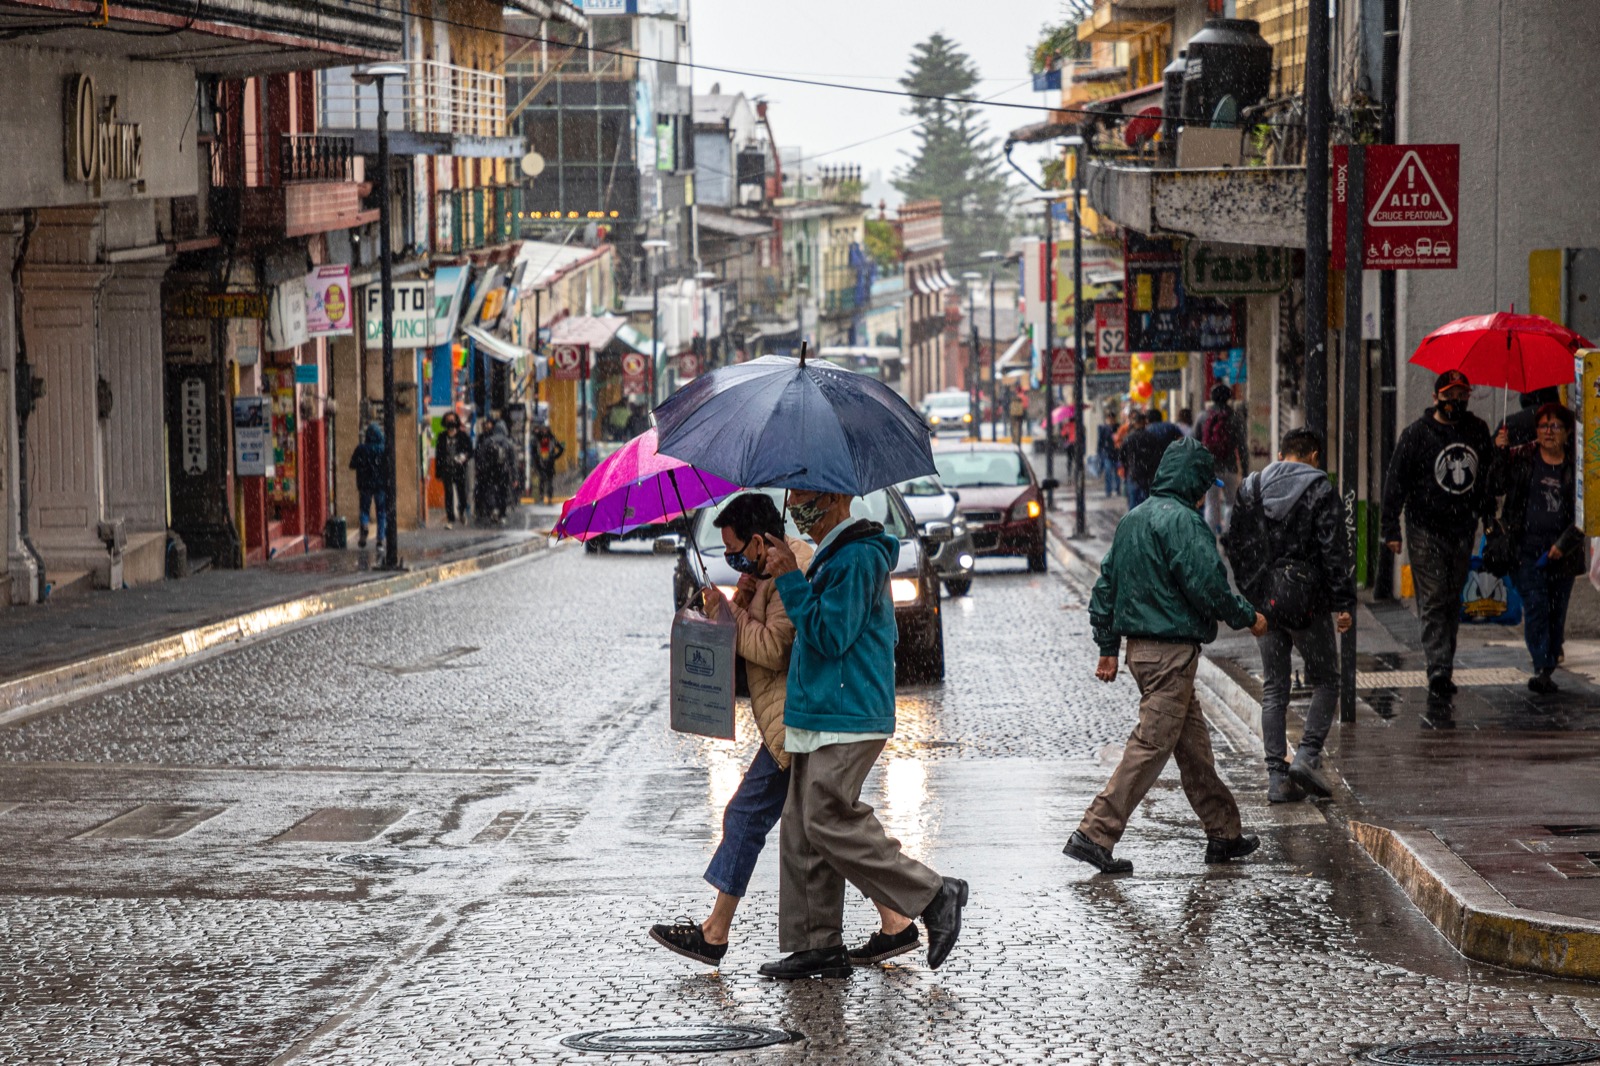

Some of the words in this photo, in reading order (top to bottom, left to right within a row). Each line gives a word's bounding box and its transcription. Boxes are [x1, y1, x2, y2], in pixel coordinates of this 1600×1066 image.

[1335, 164, 1348, 203] Xalapa
[1390, 193, 1431, 207] ALTO
[1376, 211, 1403, 221] CRUCE
[1404, 210, 1445, 220] PEATONAL
